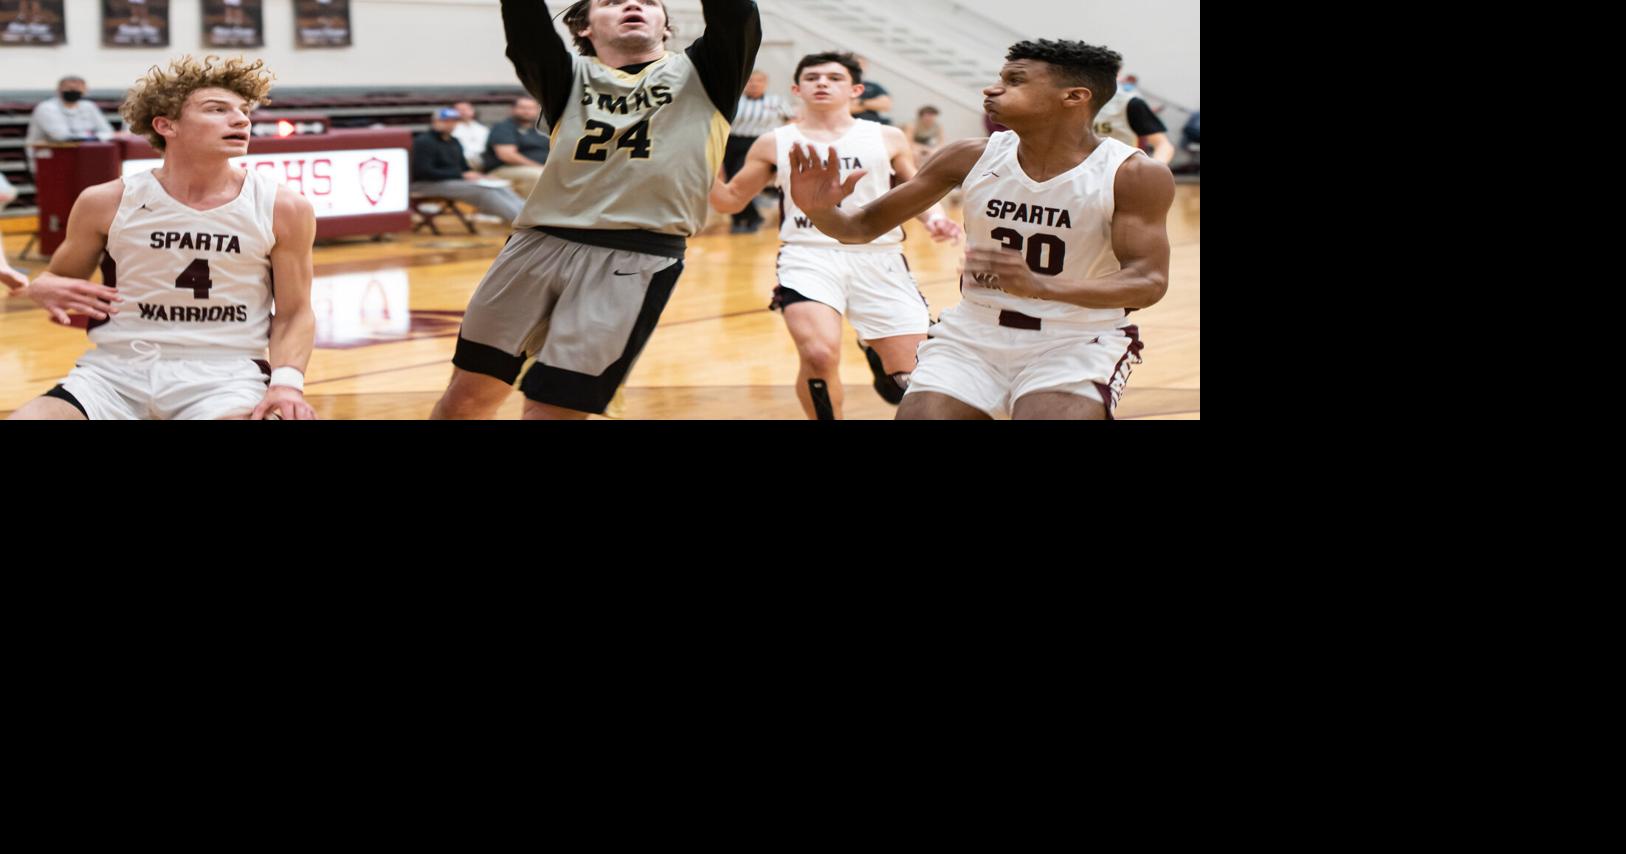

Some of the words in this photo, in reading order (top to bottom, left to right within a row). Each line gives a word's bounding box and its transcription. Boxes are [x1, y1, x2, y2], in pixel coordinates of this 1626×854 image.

[573, 118, 652, 162] 24
[986, 199, 1072, 229] SPARTA
[150, 231, 241, 254] SPARTA
[175, 258, 213, 300] 4
[138, 302, 248, 323] WARRIORS
